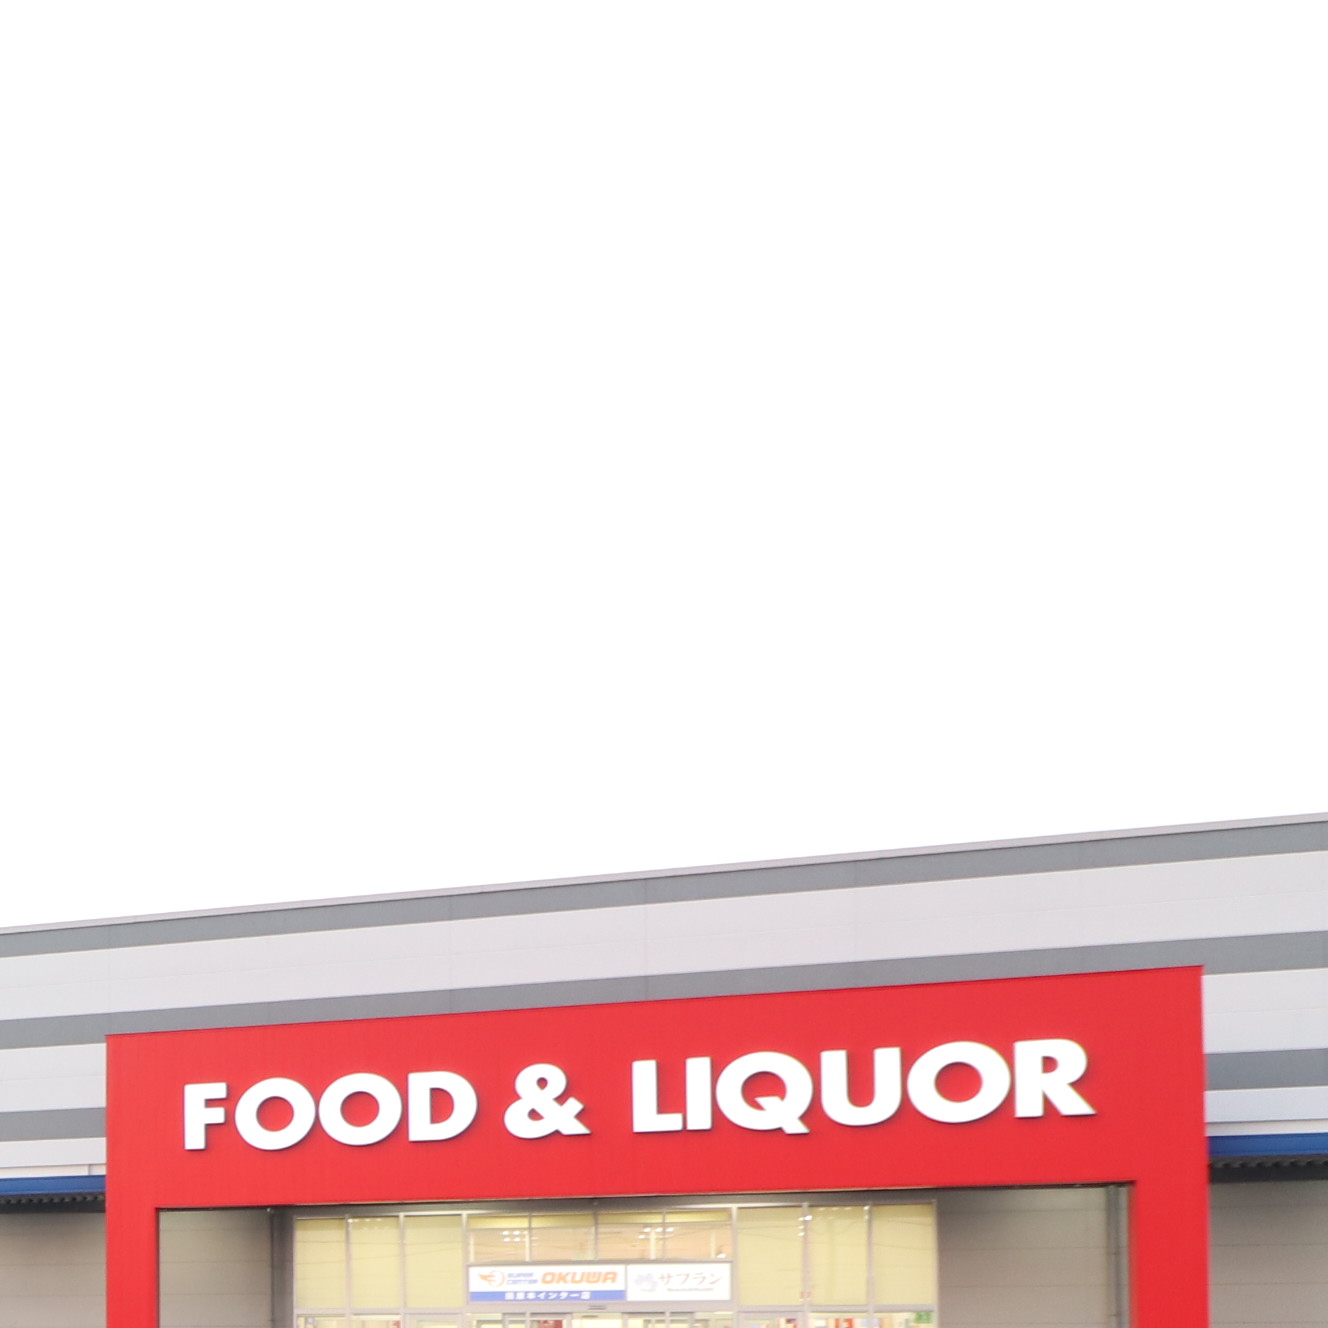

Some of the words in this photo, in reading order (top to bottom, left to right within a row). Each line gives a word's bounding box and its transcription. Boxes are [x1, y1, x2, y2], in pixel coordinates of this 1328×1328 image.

[183, 1070, 478, 1152] FOOD
[504, 1063, 591, 1139] &
[631, 1039, 1097, 1135] LIQUOR
[541, 1271, 618, 1285] OKUWA
[658, 1272, 721, 1286] サフラン
